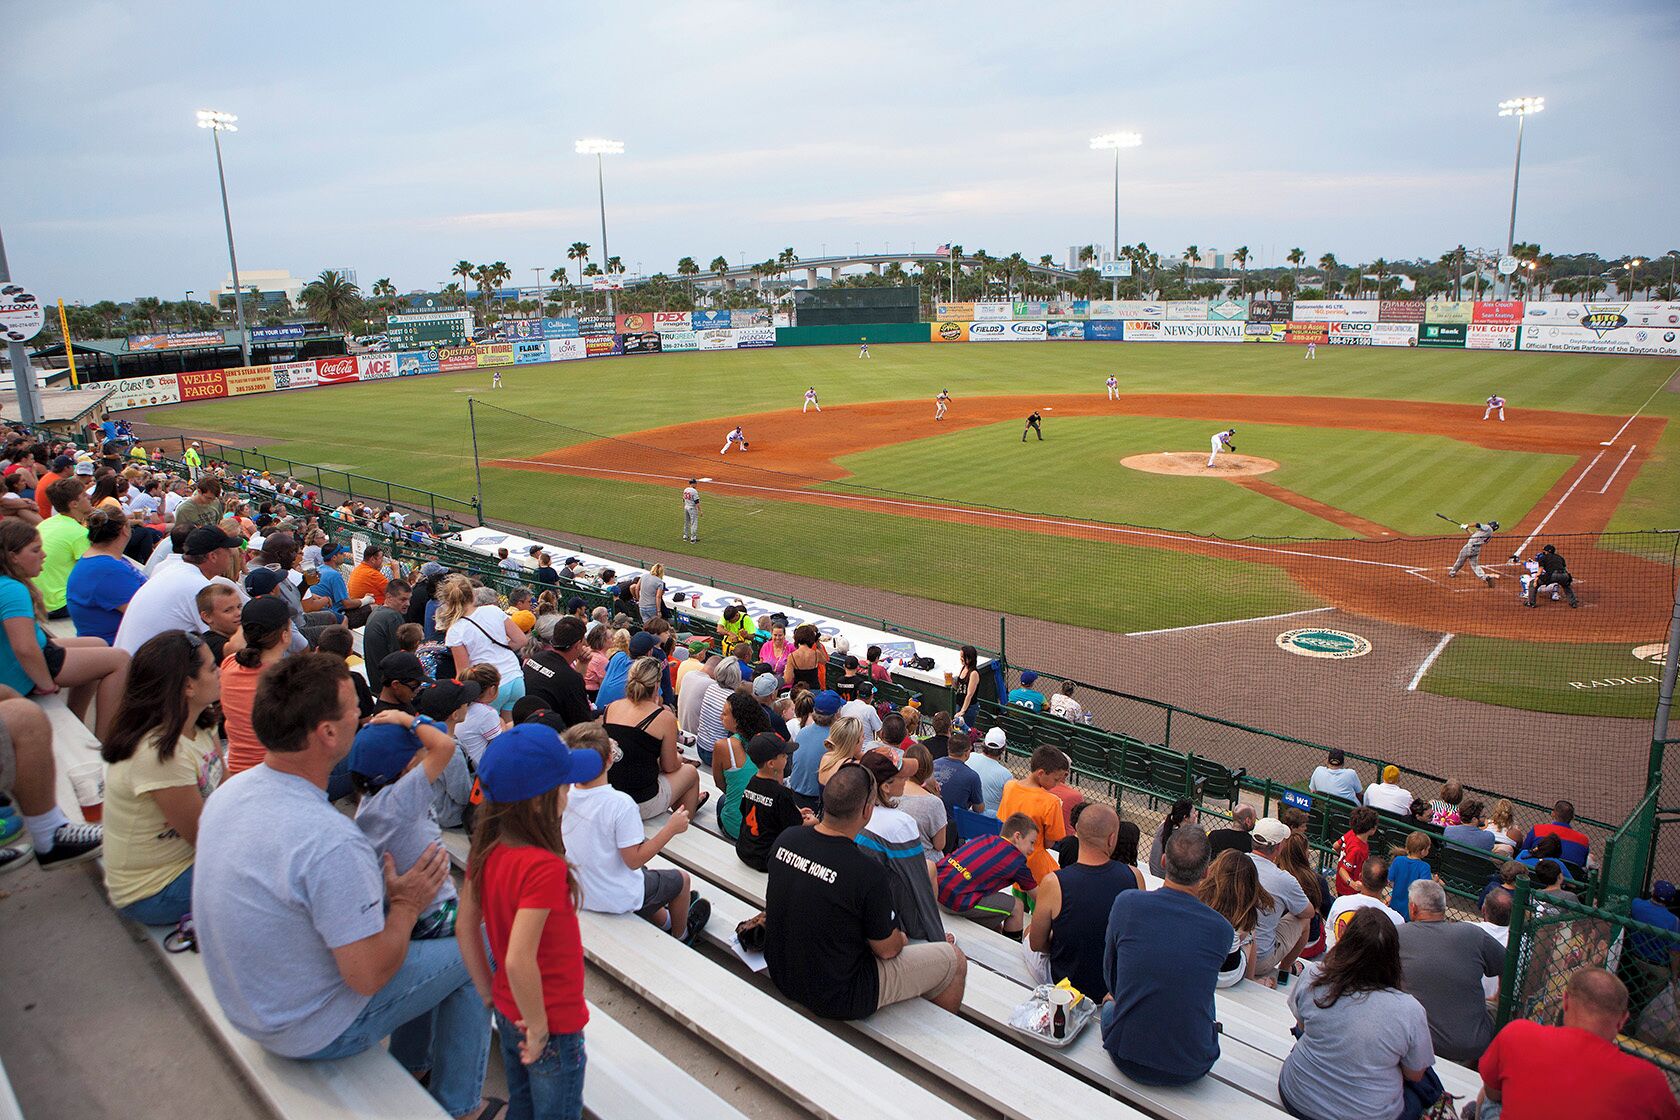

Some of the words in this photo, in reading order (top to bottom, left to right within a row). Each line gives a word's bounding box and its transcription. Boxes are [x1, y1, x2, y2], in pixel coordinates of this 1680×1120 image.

[0, 303, 39, 311] YTONA
[656, 312, 687, 323] DEX
[1589, 314, 1619, 322] AUTO
[975, 325, 1000, 333] FIELDS
[1163, 325, 1244, 337] NEWS-JOURNAL
[1331, 322, 1371, 332] KENCO
[1467, 325, 1489, 333] FIVE
[1490, 325, 1517, 333] GUYS
[661, 332, 695, 341] TRUGREEN
[477, 345, 490, 355] GET
[491, 344, 513, 354] MORE!
[519, 344, 540, 353] FLAIR
[559, 345, 577, 353] LOWE
[1629, 346, 1658, 354] Daytona
[365, 360, 390, 375] ACE
[181, 372, 223, 385] WELLS
[184, 384, 224, 398] FARGO
[1296, 796, 1309, 807] W1
[745, 804, 760, 836] 4
[775, 846, 811, 873] KEYSTONE
[809, 861, 838, 884] HOMES
[947, 857, 965, 875] unicef
